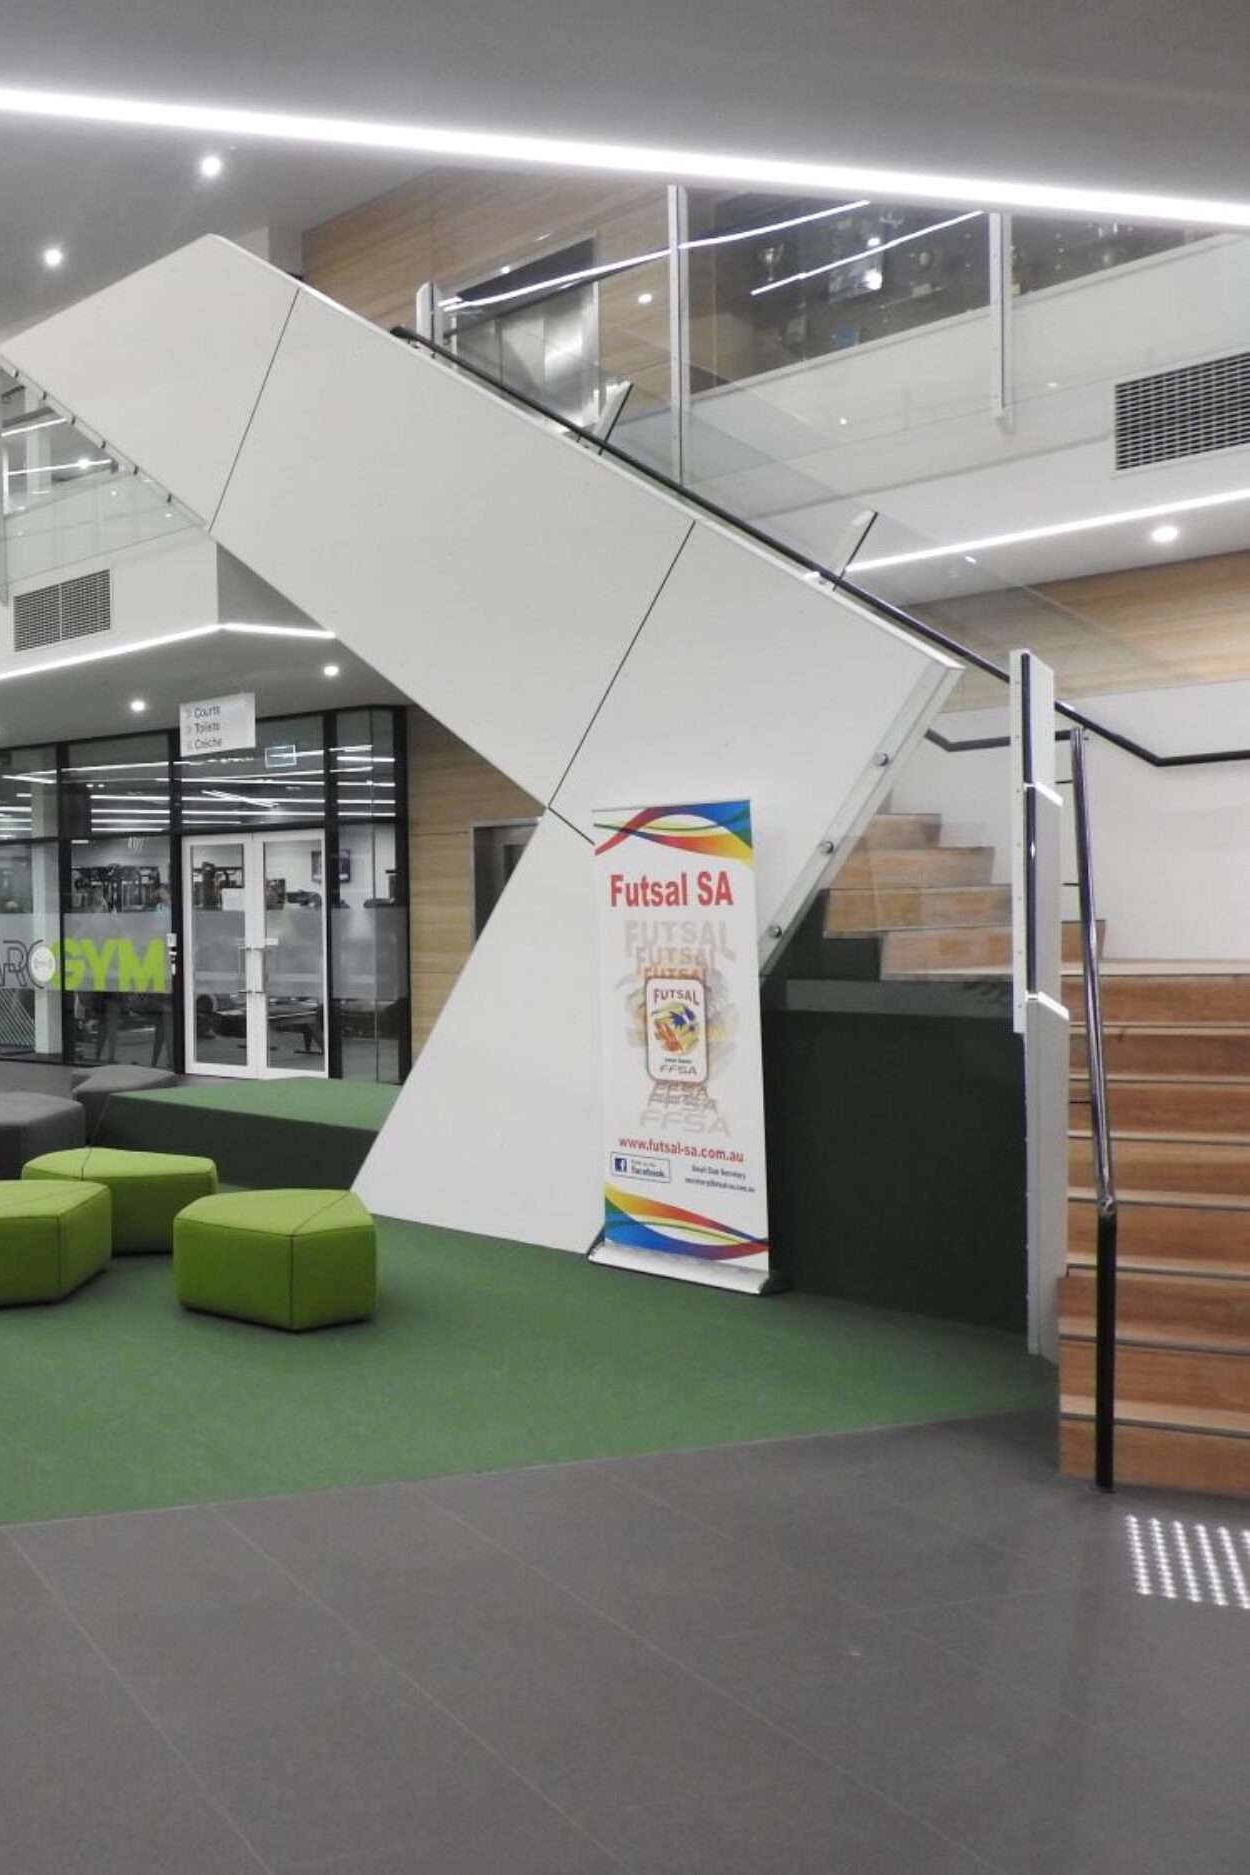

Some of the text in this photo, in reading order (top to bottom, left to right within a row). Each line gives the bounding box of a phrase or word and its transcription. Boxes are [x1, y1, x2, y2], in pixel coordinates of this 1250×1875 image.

[610, 870, 735, 907] Futsal SA
[625, 919, 737, 961] FUTSAL
[51, 936, 166, 992] GYM
[654, 988, 699, 1006] FUTSAL
[660, 1064, 697, 1074] FFSA
[641, 1110, 730, 1136] FFSA
[618, 1136, 744, 1163] www.futsal-sa.com.au
